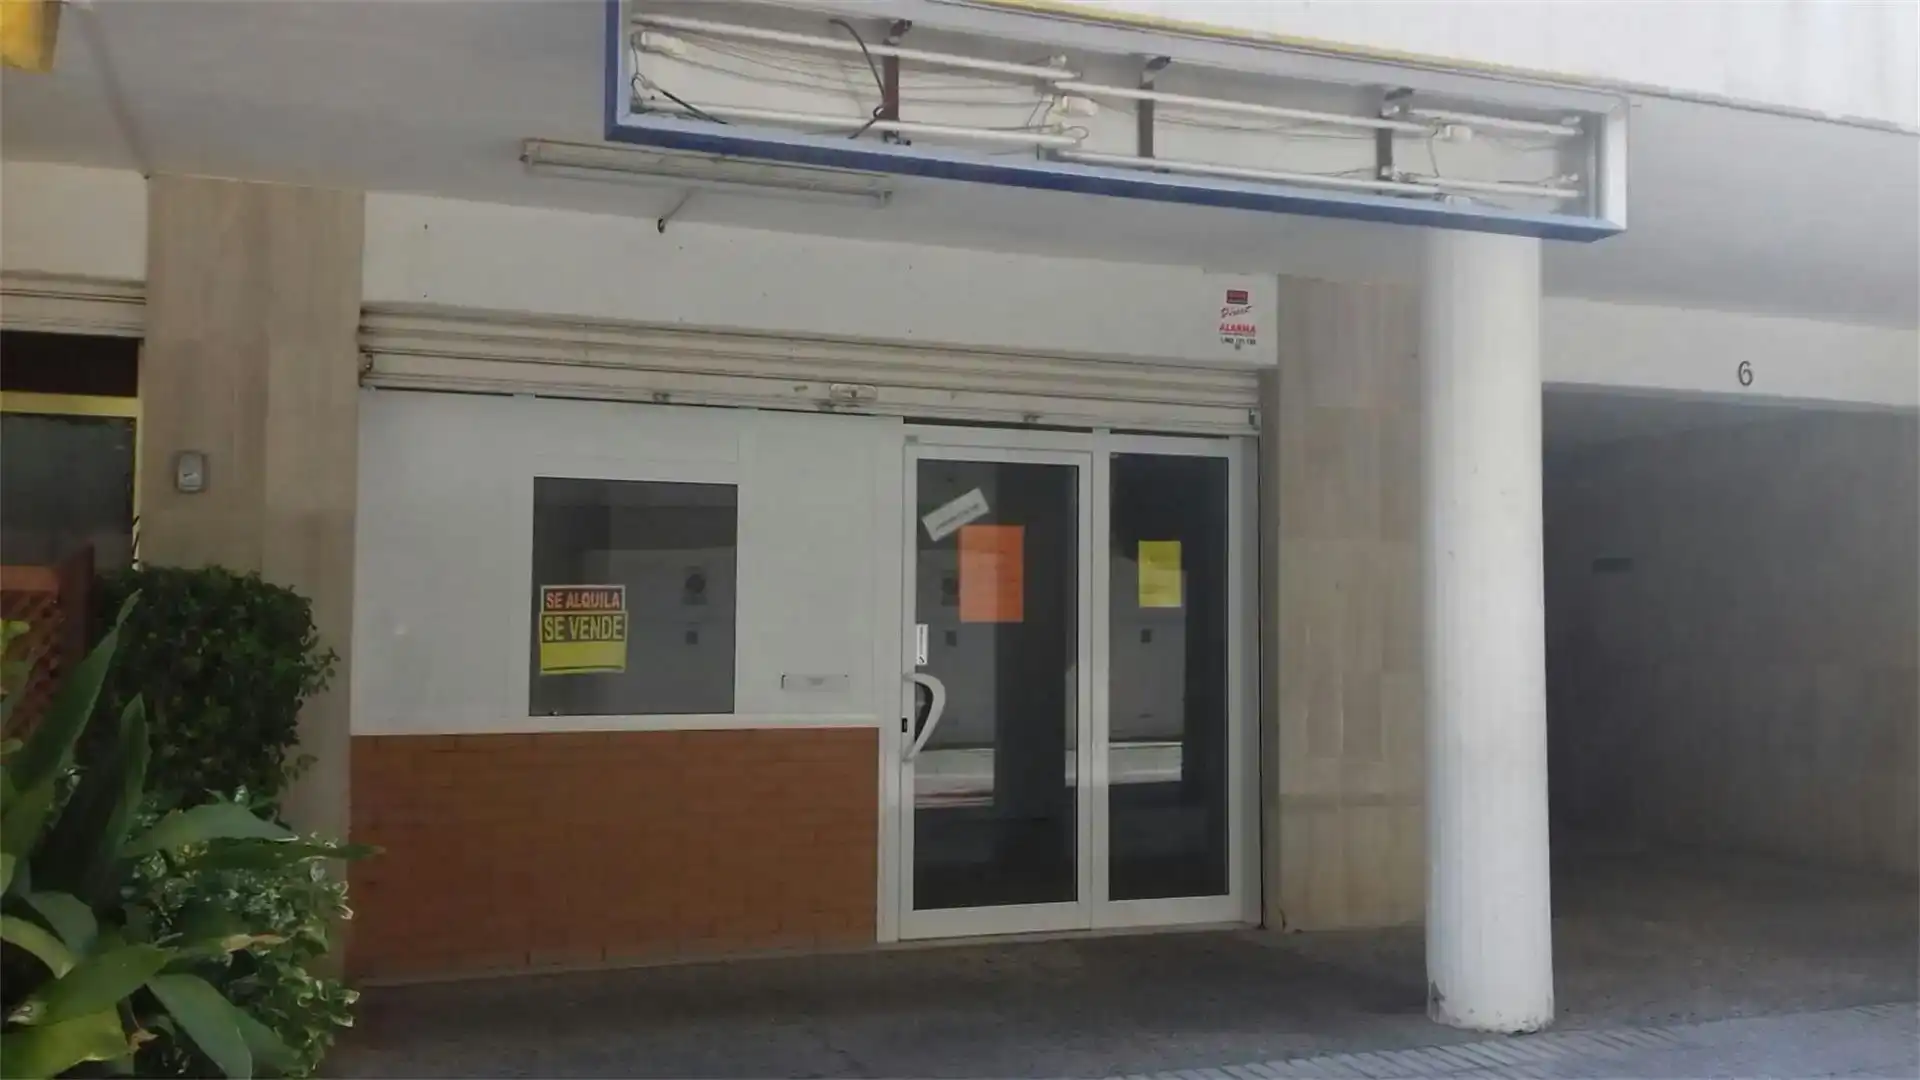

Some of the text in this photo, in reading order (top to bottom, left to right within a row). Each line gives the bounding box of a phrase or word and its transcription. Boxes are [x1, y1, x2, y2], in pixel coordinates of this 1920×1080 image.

[1219, 323, 1255, 334] ALARMA
[1738, 360, 1753, 386] 6
[546, 592, 620, 609] SE ALQUILA
[544, 616, 623, 640] SE VENDE
